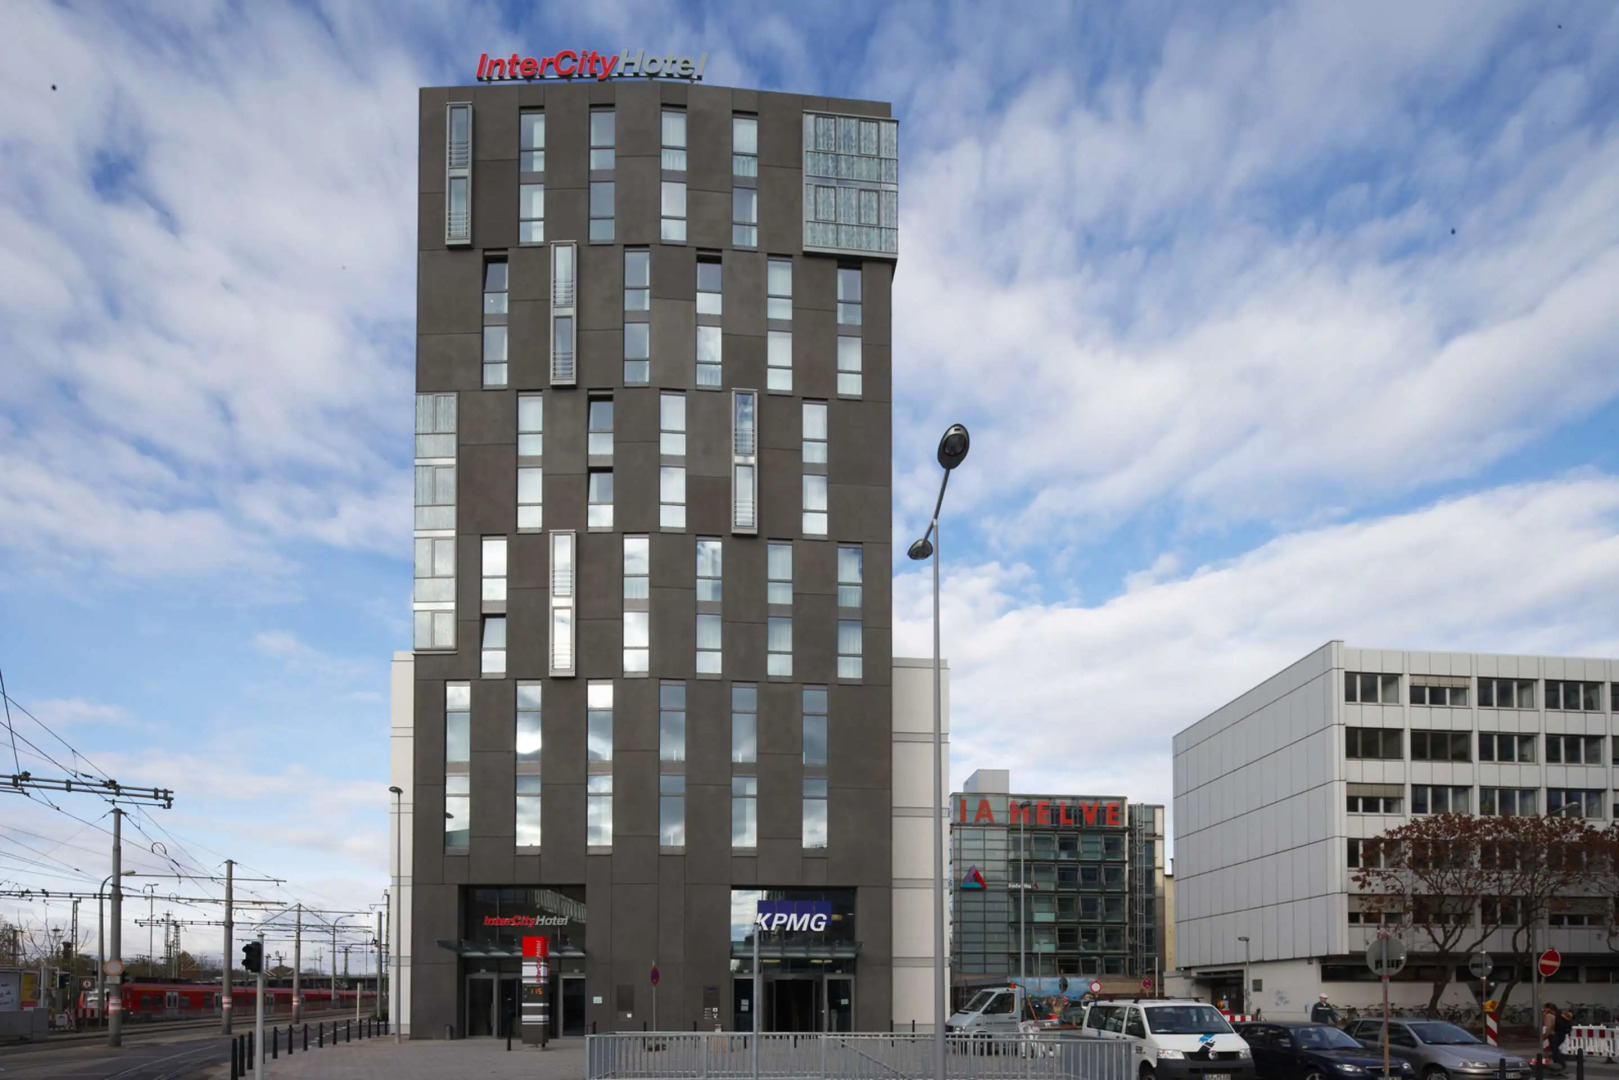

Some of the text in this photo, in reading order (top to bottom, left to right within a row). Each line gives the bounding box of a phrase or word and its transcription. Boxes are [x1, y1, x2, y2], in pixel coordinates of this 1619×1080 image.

[476, 48, 708, 80] InterCityHotel
[959, 797, 1121, 826] IA HELVE
[484, 914, 569, 928] InterCityHotel
[756, 912, 828, 932] KPMG
